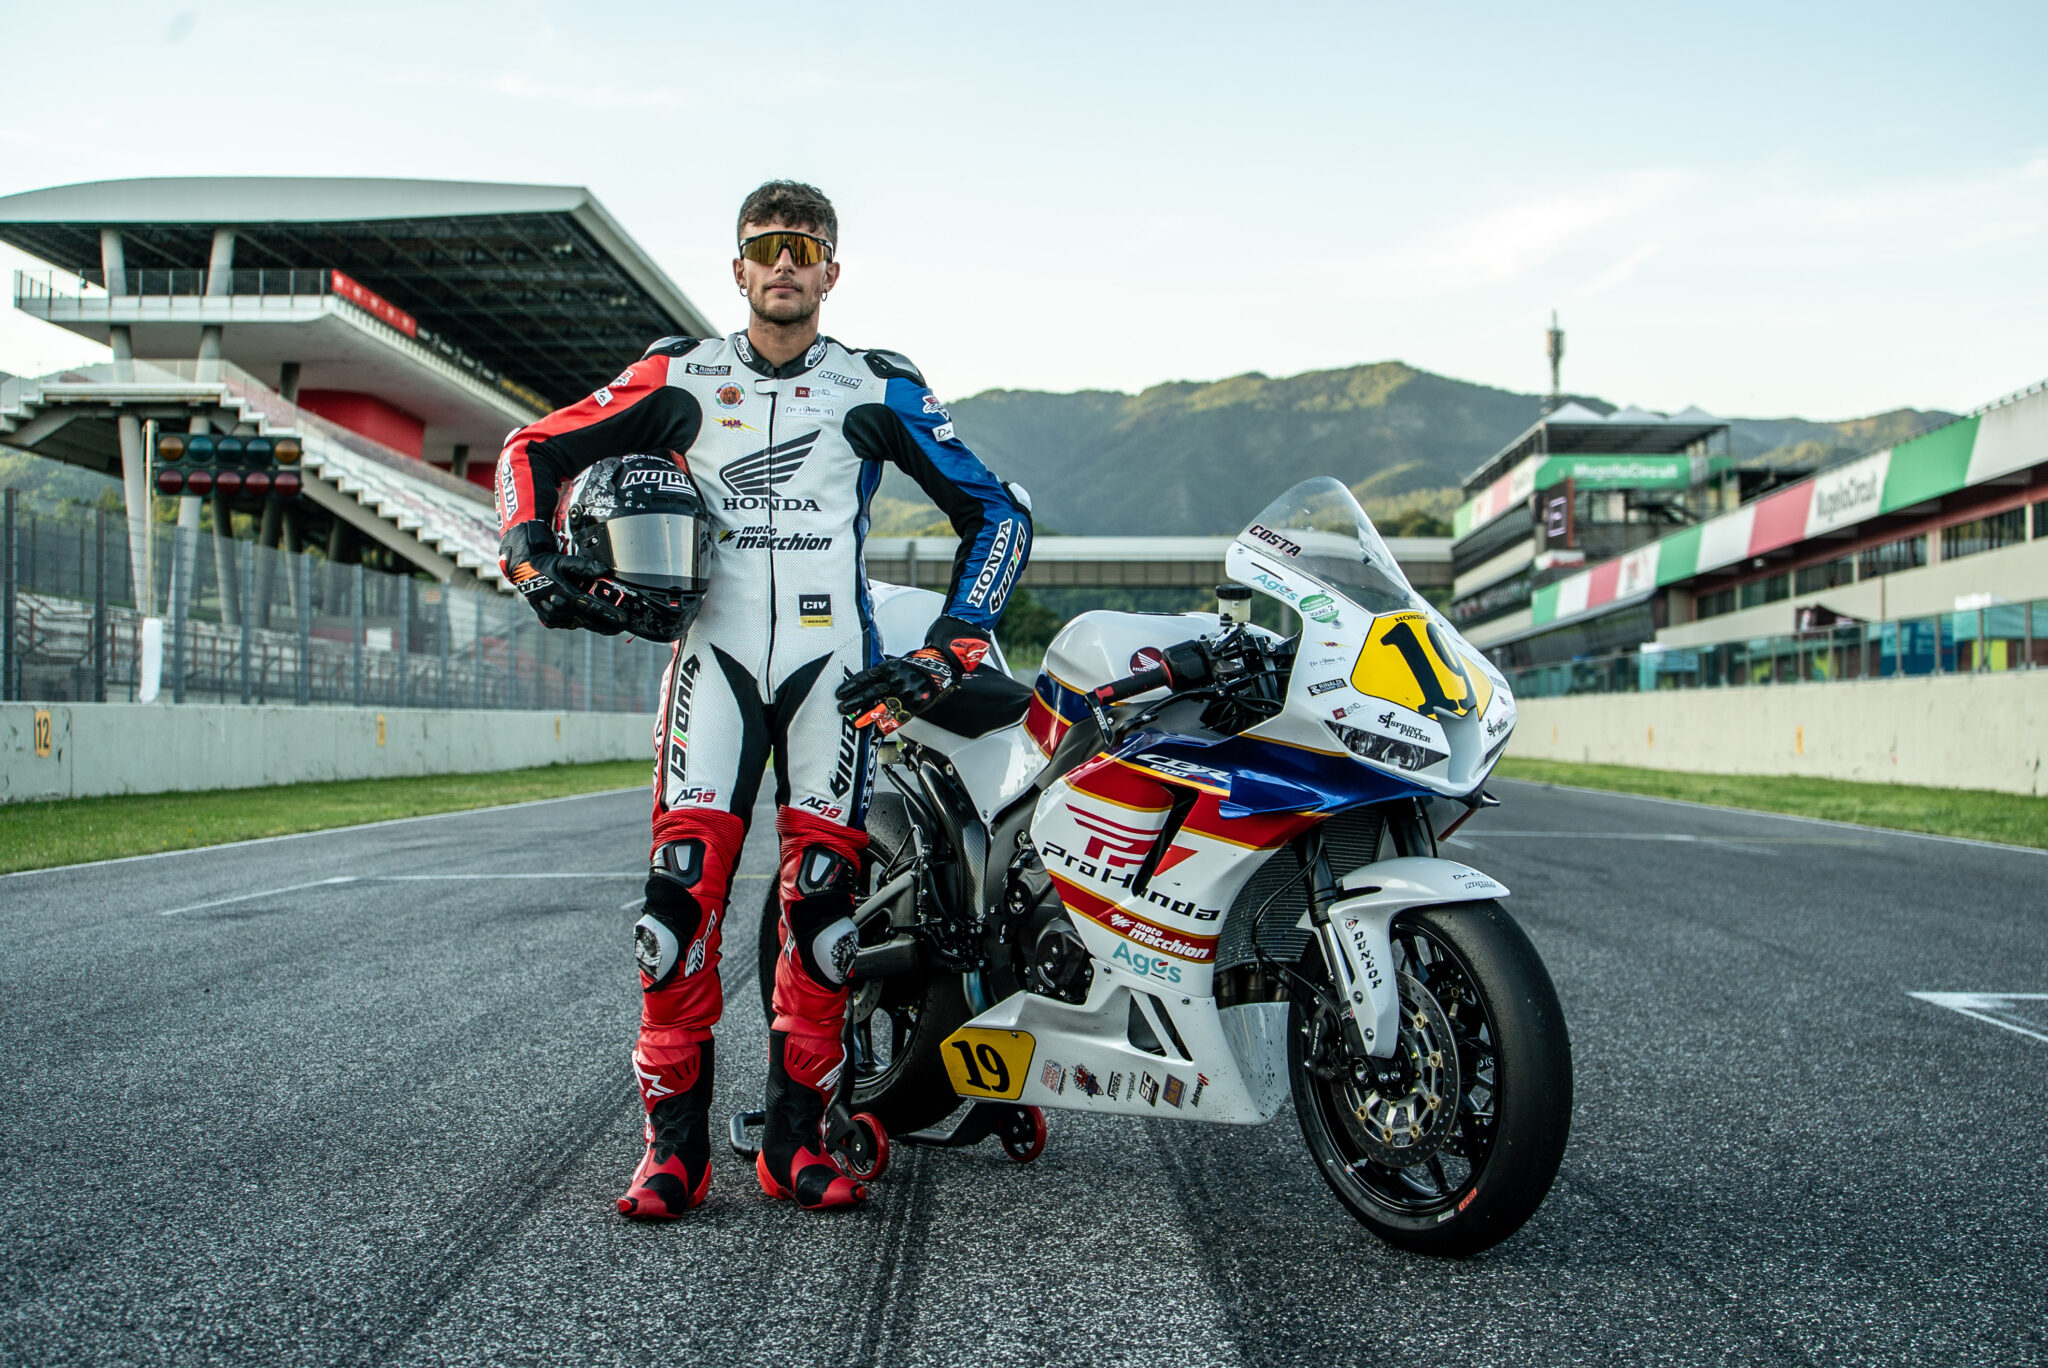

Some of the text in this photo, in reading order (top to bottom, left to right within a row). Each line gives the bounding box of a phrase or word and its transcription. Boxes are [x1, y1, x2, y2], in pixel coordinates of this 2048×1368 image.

[819, 371, 862, 388] NOLAN
[722, 497, 822, 512] HONDA
[736, 533, 833, 551] macchion
[742, 525, 777, 536] moto
[1249, 525, 1302, 557] COSTA
[968, 521, 1011, 607] HONDA
[1252, 574, 1299, 601] Agos
[802, 601, 827, 610] CIV
[1380, 622, 1477, 717] 19
[36, 717, 49, 749] 12
[1390, 720, 1424, 733] SPRINT
[1399, 727, 1431, 744] FILTER
[1136, 753, 1231, 784] CBR
[1041, 841, 1221, 921] ProHnda
[1128, 929, 1210, 959] macchion
[1134, 922, 1163, 937] moto
[1112, 941, 1181, 984] Agos
[1353, 931, 1383, 989] DUNLOP
[951, 1040, 1010, 1093] 19
[1140, 1073, 1153, 1101] SC
